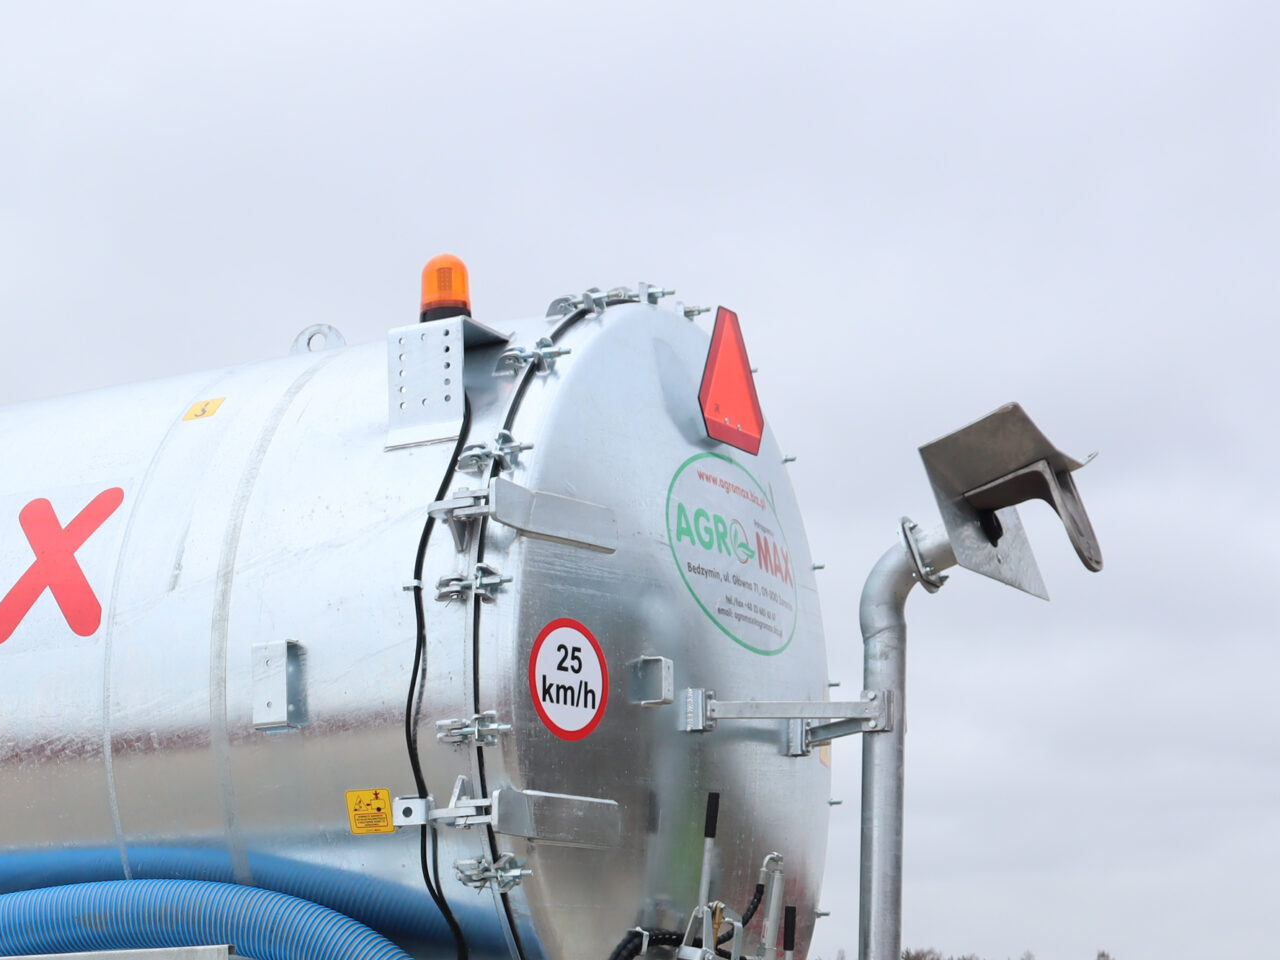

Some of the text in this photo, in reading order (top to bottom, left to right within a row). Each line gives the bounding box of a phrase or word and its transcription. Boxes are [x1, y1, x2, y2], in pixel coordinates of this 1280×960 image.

[756, 531, 794, 590] MAX
[556, 643, 583, 674] 25
[542, 674, 596, 710] km/h
